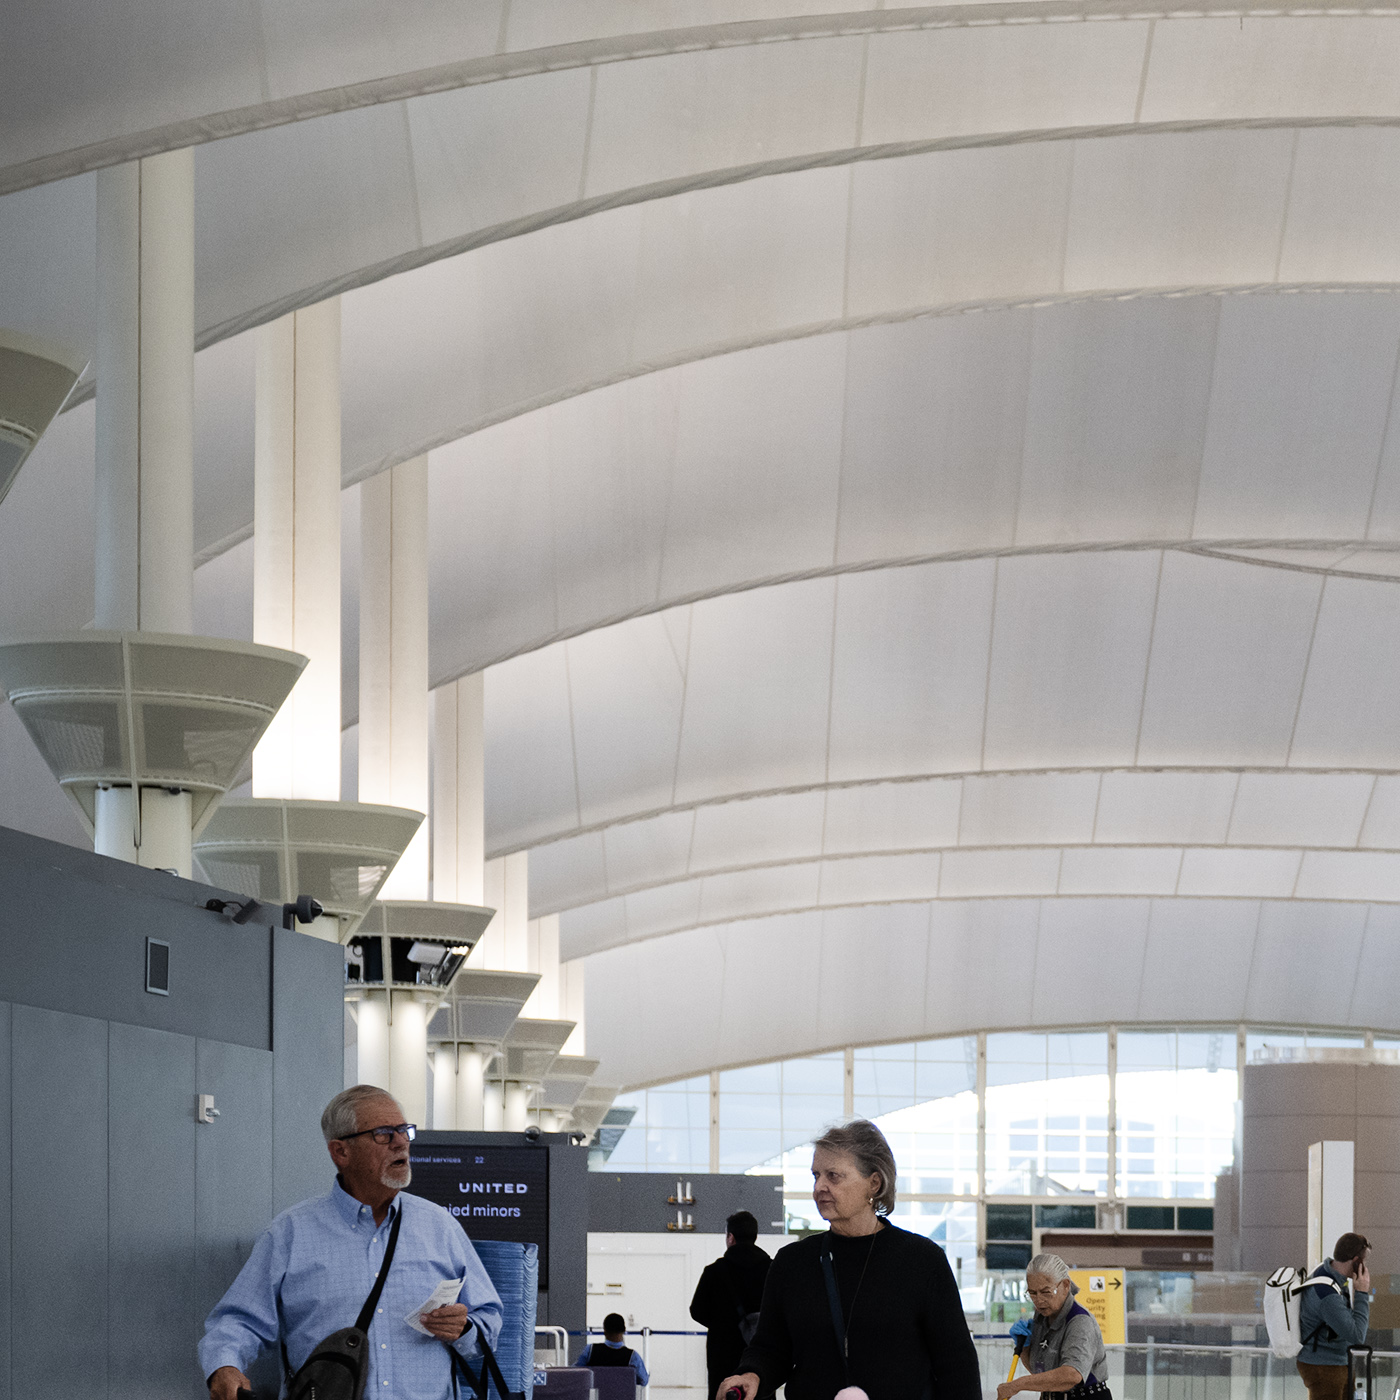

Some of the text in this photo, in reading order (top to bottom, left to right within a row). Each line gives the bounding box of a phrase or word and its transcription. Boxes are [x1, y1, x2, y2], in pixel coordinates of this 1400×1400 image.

[433, 1156, 461, 1164] services
[474, 1156, 485, 1164] 22
[458, 1182, 528, 1194] UNITED
[473, 1204, 521, 1217] minors
